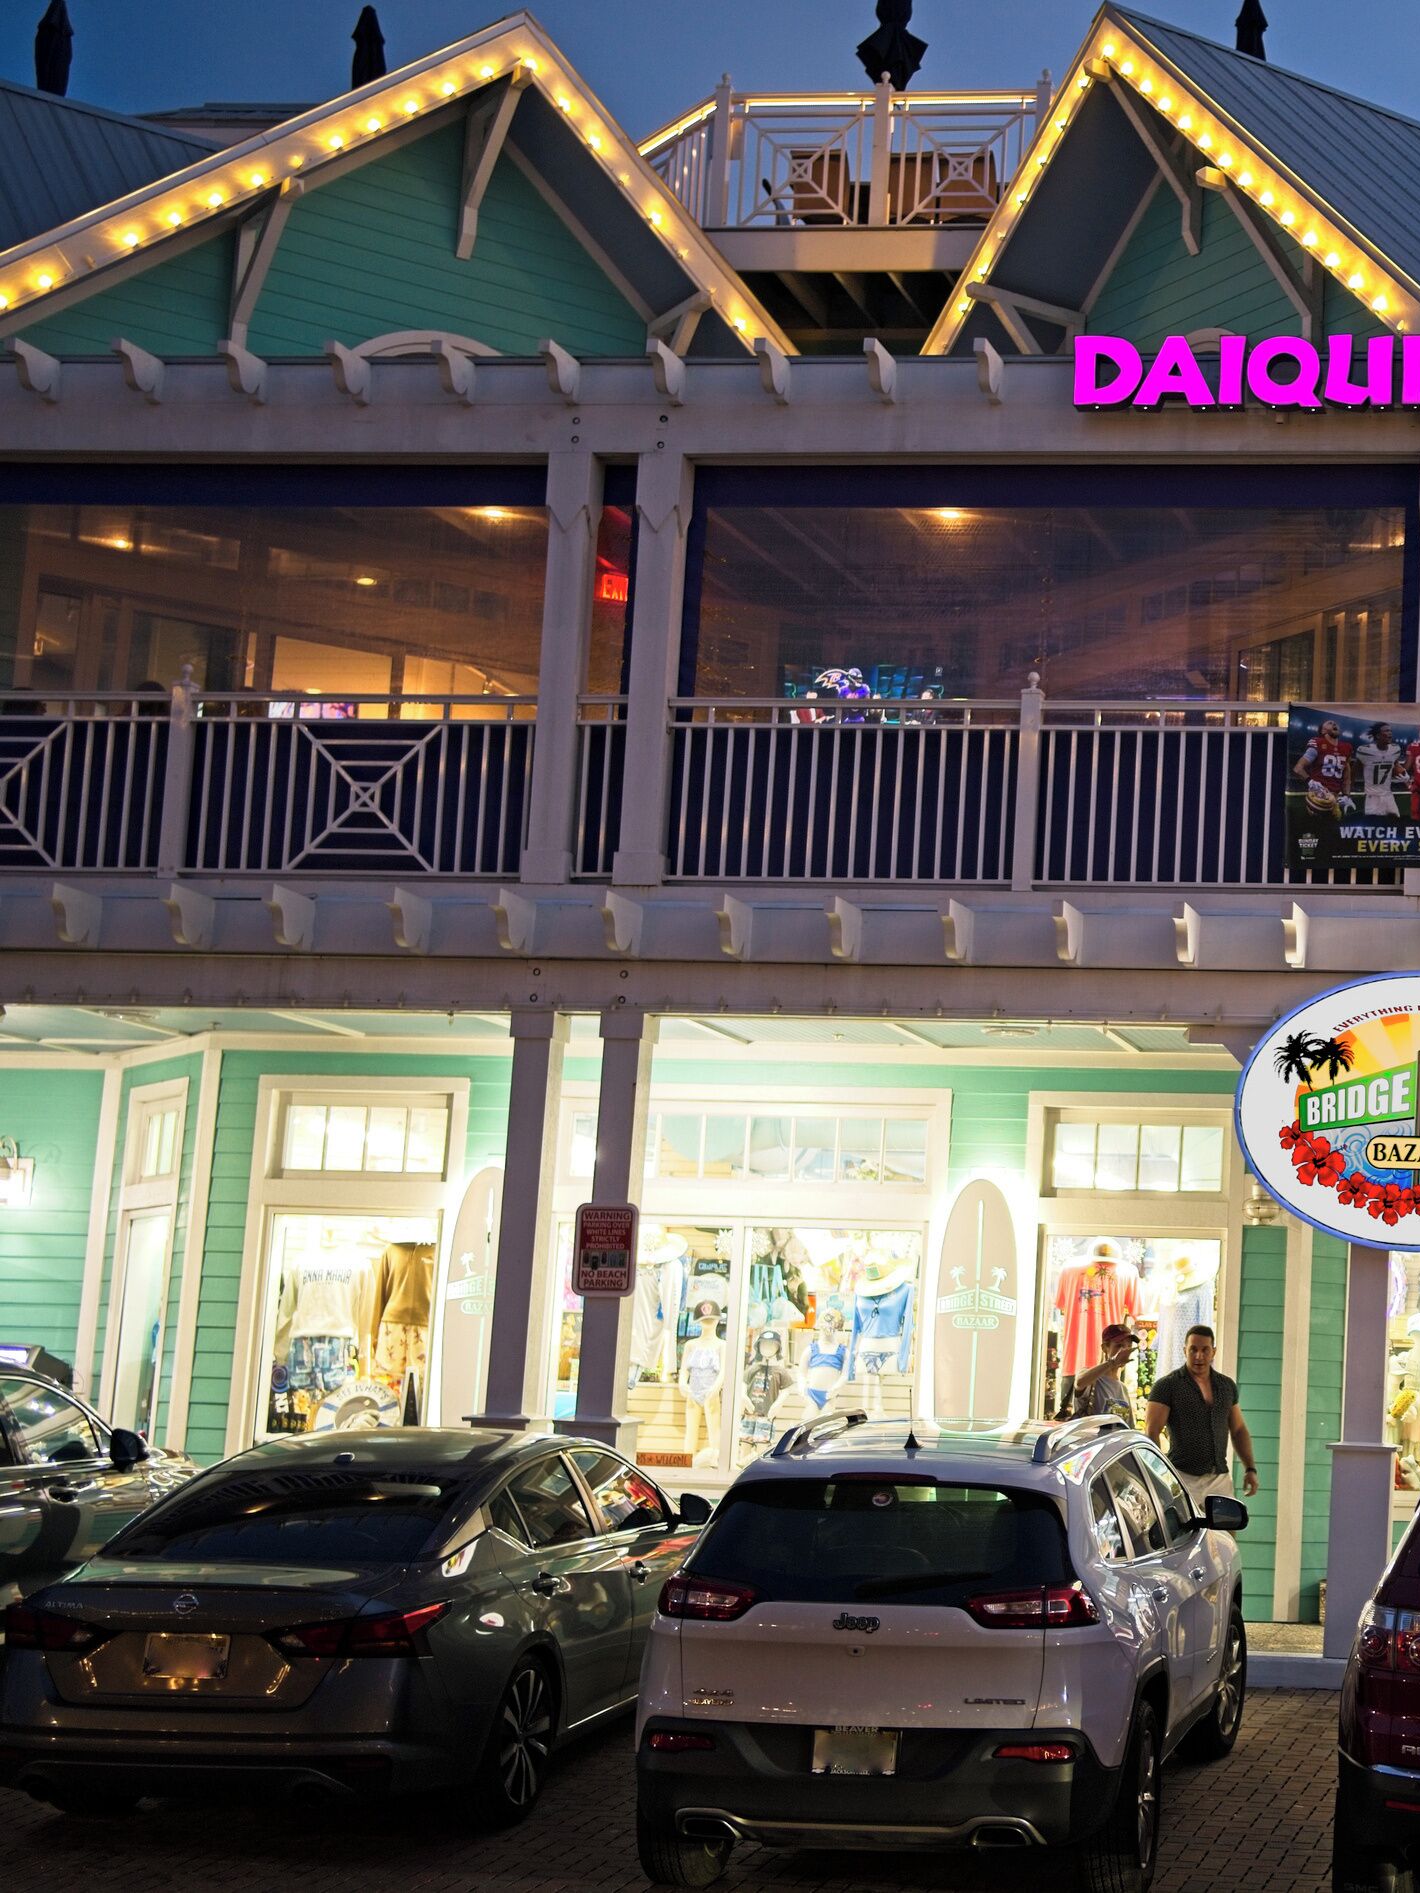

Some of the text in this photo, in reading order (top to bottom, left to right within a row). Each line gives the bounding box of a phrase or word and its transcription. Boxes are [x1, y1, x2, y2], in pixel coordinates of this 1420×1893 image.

[1321, 754, 1347, 779] 85
[1373, 764, 1393, 785] 17
[1339, 826, 1397, 840] WATCH
[1357, 840, 1411, 853] EVERY
[1332, 1005, 1413, 1033] EVERYTHING
[1306, 1070, 1412, 1127] BRIDGE
[584, 1211, 630, 1219] WARNING
[584, 1280, 623, 1288] PARKING
[956, 1317, 995, 1327] BAZAAR
[44, 1601, 84, 1609] ALTIMA
[833, 1613, 880, 1633] Jeep
